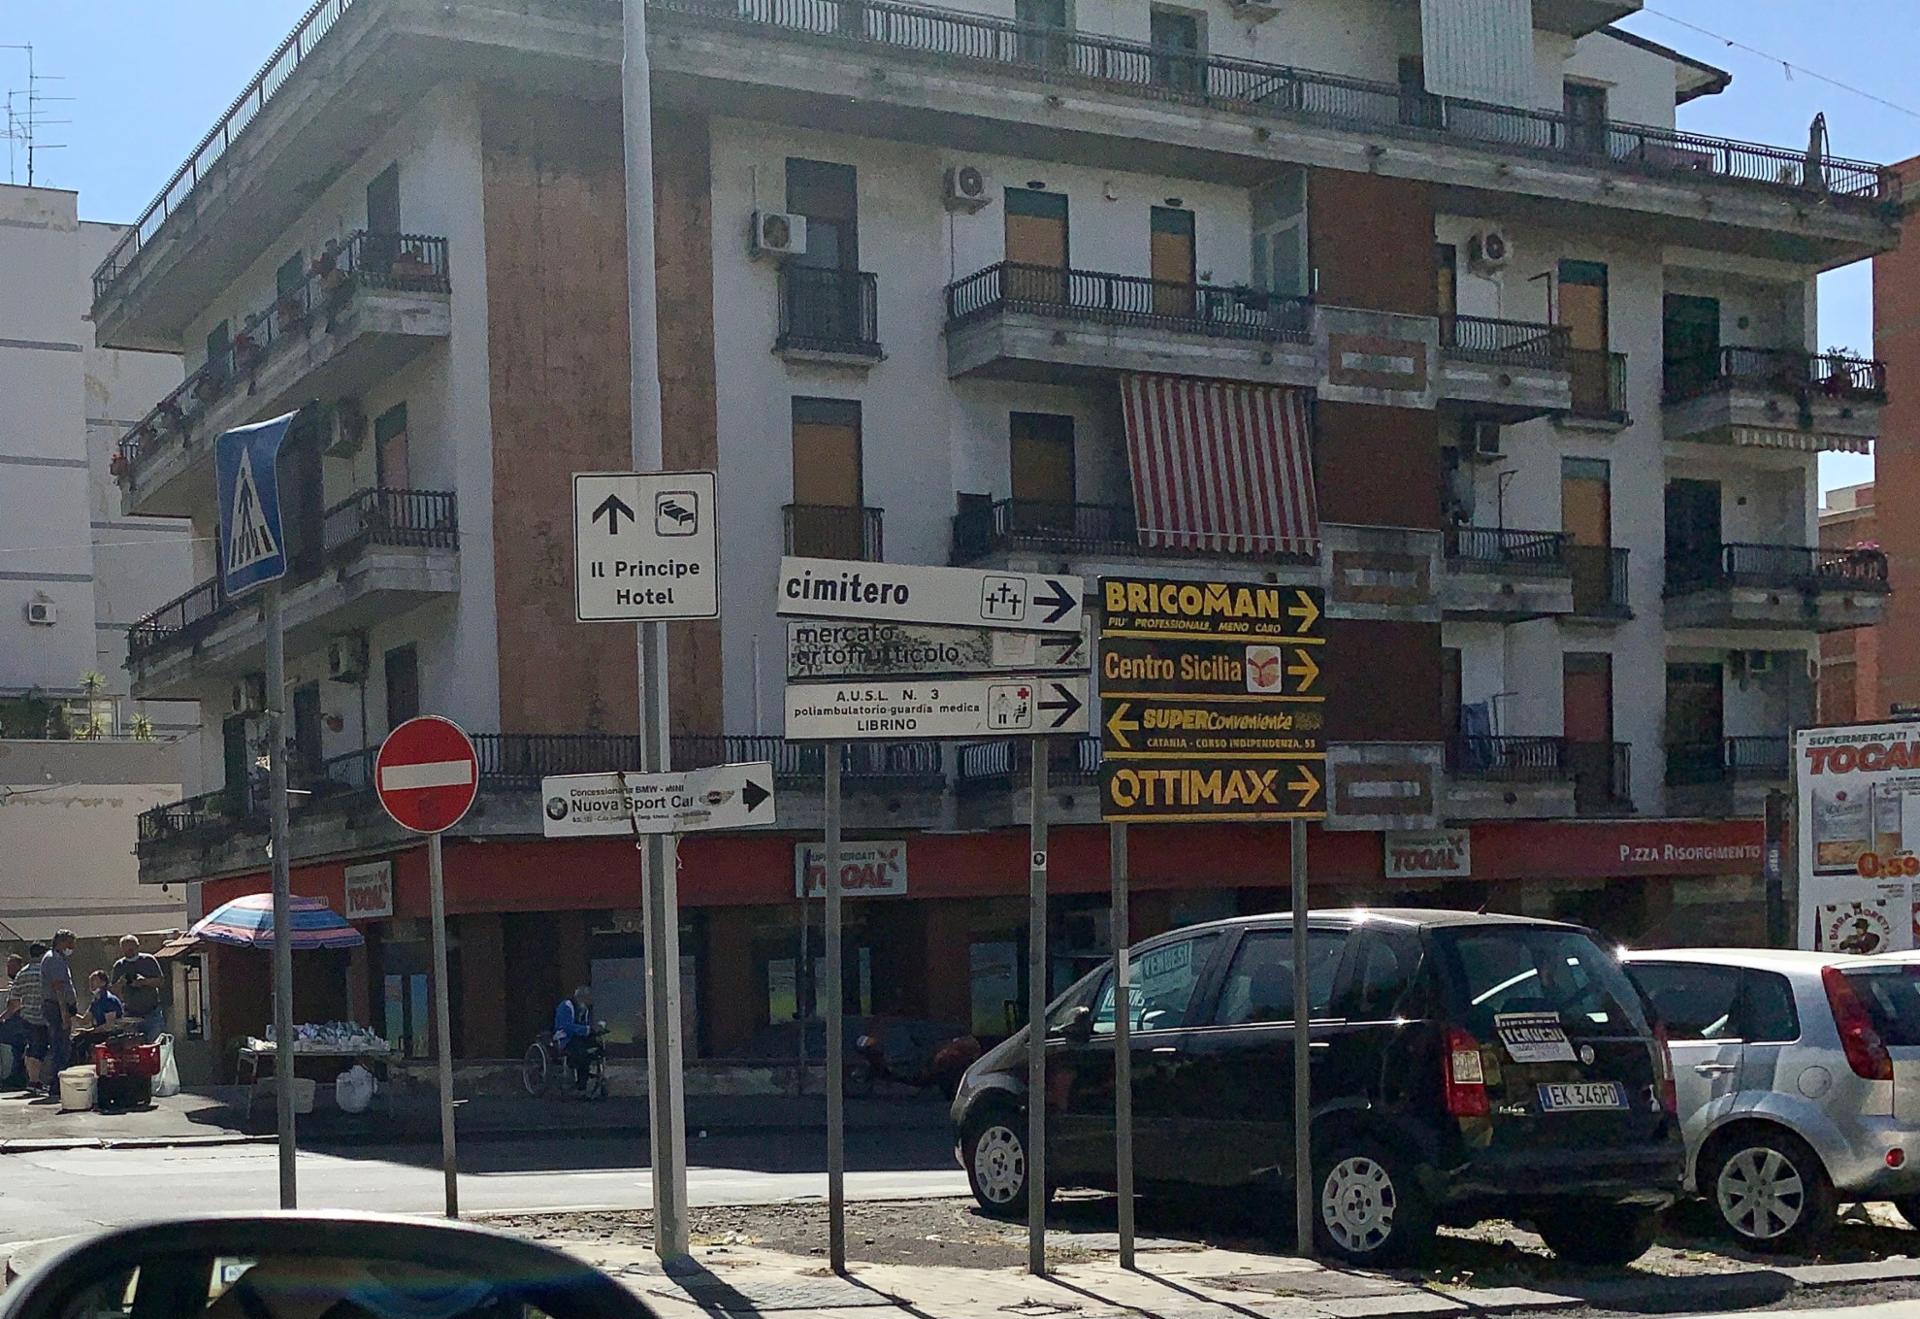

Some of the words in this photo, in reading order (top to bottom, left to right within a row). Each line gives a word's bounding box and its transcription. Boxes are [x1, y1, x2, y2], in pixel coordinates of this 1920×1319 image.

[591, 561, 605, 578] Il
[615, 559, 700, 579] Principe
[616, 587, 674, 605] Hotel
[786, 570, 909, 606] cimitero
[1105, 581, 1279, 618] BRICOMAN
[796, 623, 892, 644] mercato
[1218, 622, 1249, 632] MENO
[1255, 624, 1281, 633] CARO
[1105, 651, 1174, 680] Centro
[1180, 654, 1242, 682] Sicilia
[836, 690, 888, 702] A.U.S.L.
[902, 690, 917, 701] N.
[931, 689, 939, 700] 3
[939, 703, 980, 713] medica
[857, 719, 917, 731] LIBRINO
[1147, 738, 1187, 748] CATANIA
[1196, 738, 1227, 748] CORSO
[1809, 732, 1907, 746] SUPERMERCATI
[635, 785, 657, 793] BMW
[1111, 768, 1279, 807] OTTIMAX
[572, 798, 618, 812] Nuova
[624, 796, 665, 811] Sport
[1829, 912, 1853, 941] BIRRA
[1551, 1086, 1572, 1105] EK
